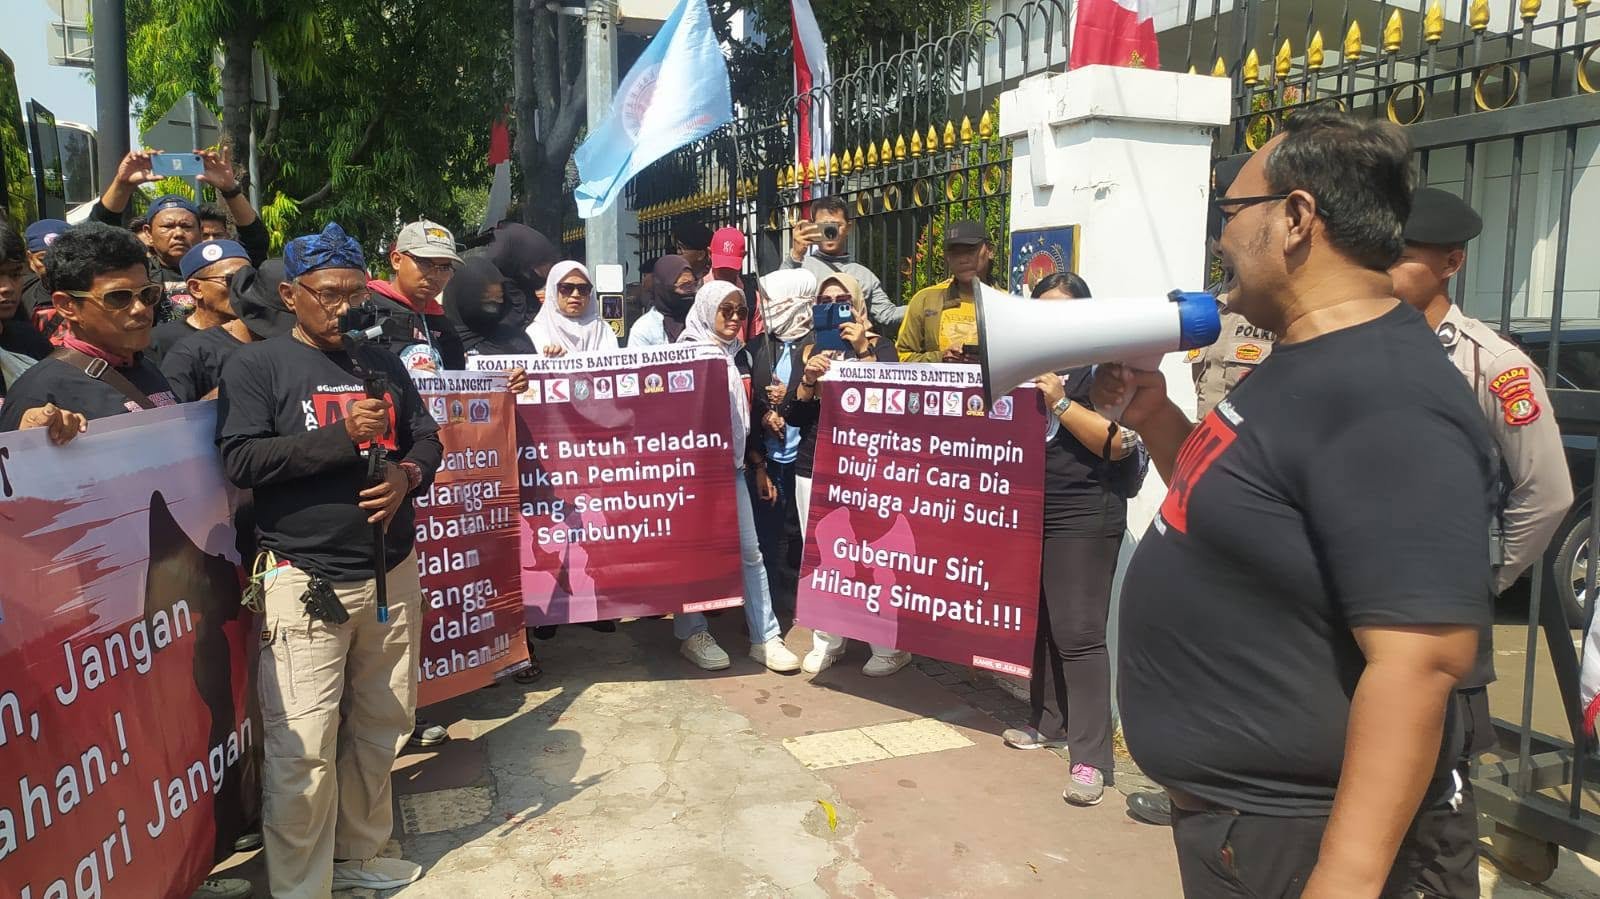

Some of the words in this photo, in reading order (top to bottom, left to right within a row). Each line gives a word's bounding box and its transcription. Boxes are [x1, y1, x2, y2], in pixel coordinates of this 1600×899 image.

[533, 357, 583, 371] AKTIVIS
[587, 353, 638, 368] BANTEN
[642, 348, 697, 365] BANGKIT
[839, 367, 876, 380] KOALISI
[878, 368, 918, 381] AKTIVIS
[921, 370, 964, 384] BANTEN
[448, 378, 493, 391] BANGKIT
[1492, 368, 1526, 389] POLDA
[558, 436, 626, 460] Butuh
[634, 429, 729, 454] Teladan,
[832, 426, 922, 457] Integritas
[929, 434, 1024, 466] Pemimpin
[588, 457, 696, 484] Pemimpin
[838, 456, 878, 482] Diuji
[883, 461, 920, 484] dari
[926, 467, 970, 490] Cara
[979, 472, 1010, 495] Dia
[574, 486, 696, 513] Sembunyi-
[828, 484, 903, 519] Menjaga
[909, 496, 957, 524] Janji
[963, 502, 1019, 529] Suci.!
[537, 518, 672, 546] Sembunyi.!!
[833, 537, 938, 576] Gubernur
[945, 557, 991, 592] Siri,
[811, 568, 882, 613] Hilang
[889, 583, 1022, 631] Simpati.!!!
[429, 610, 496, 644] dalam
[55, 599, 194, 706] Jangan
[147, 717, 253, 839] Jangan
